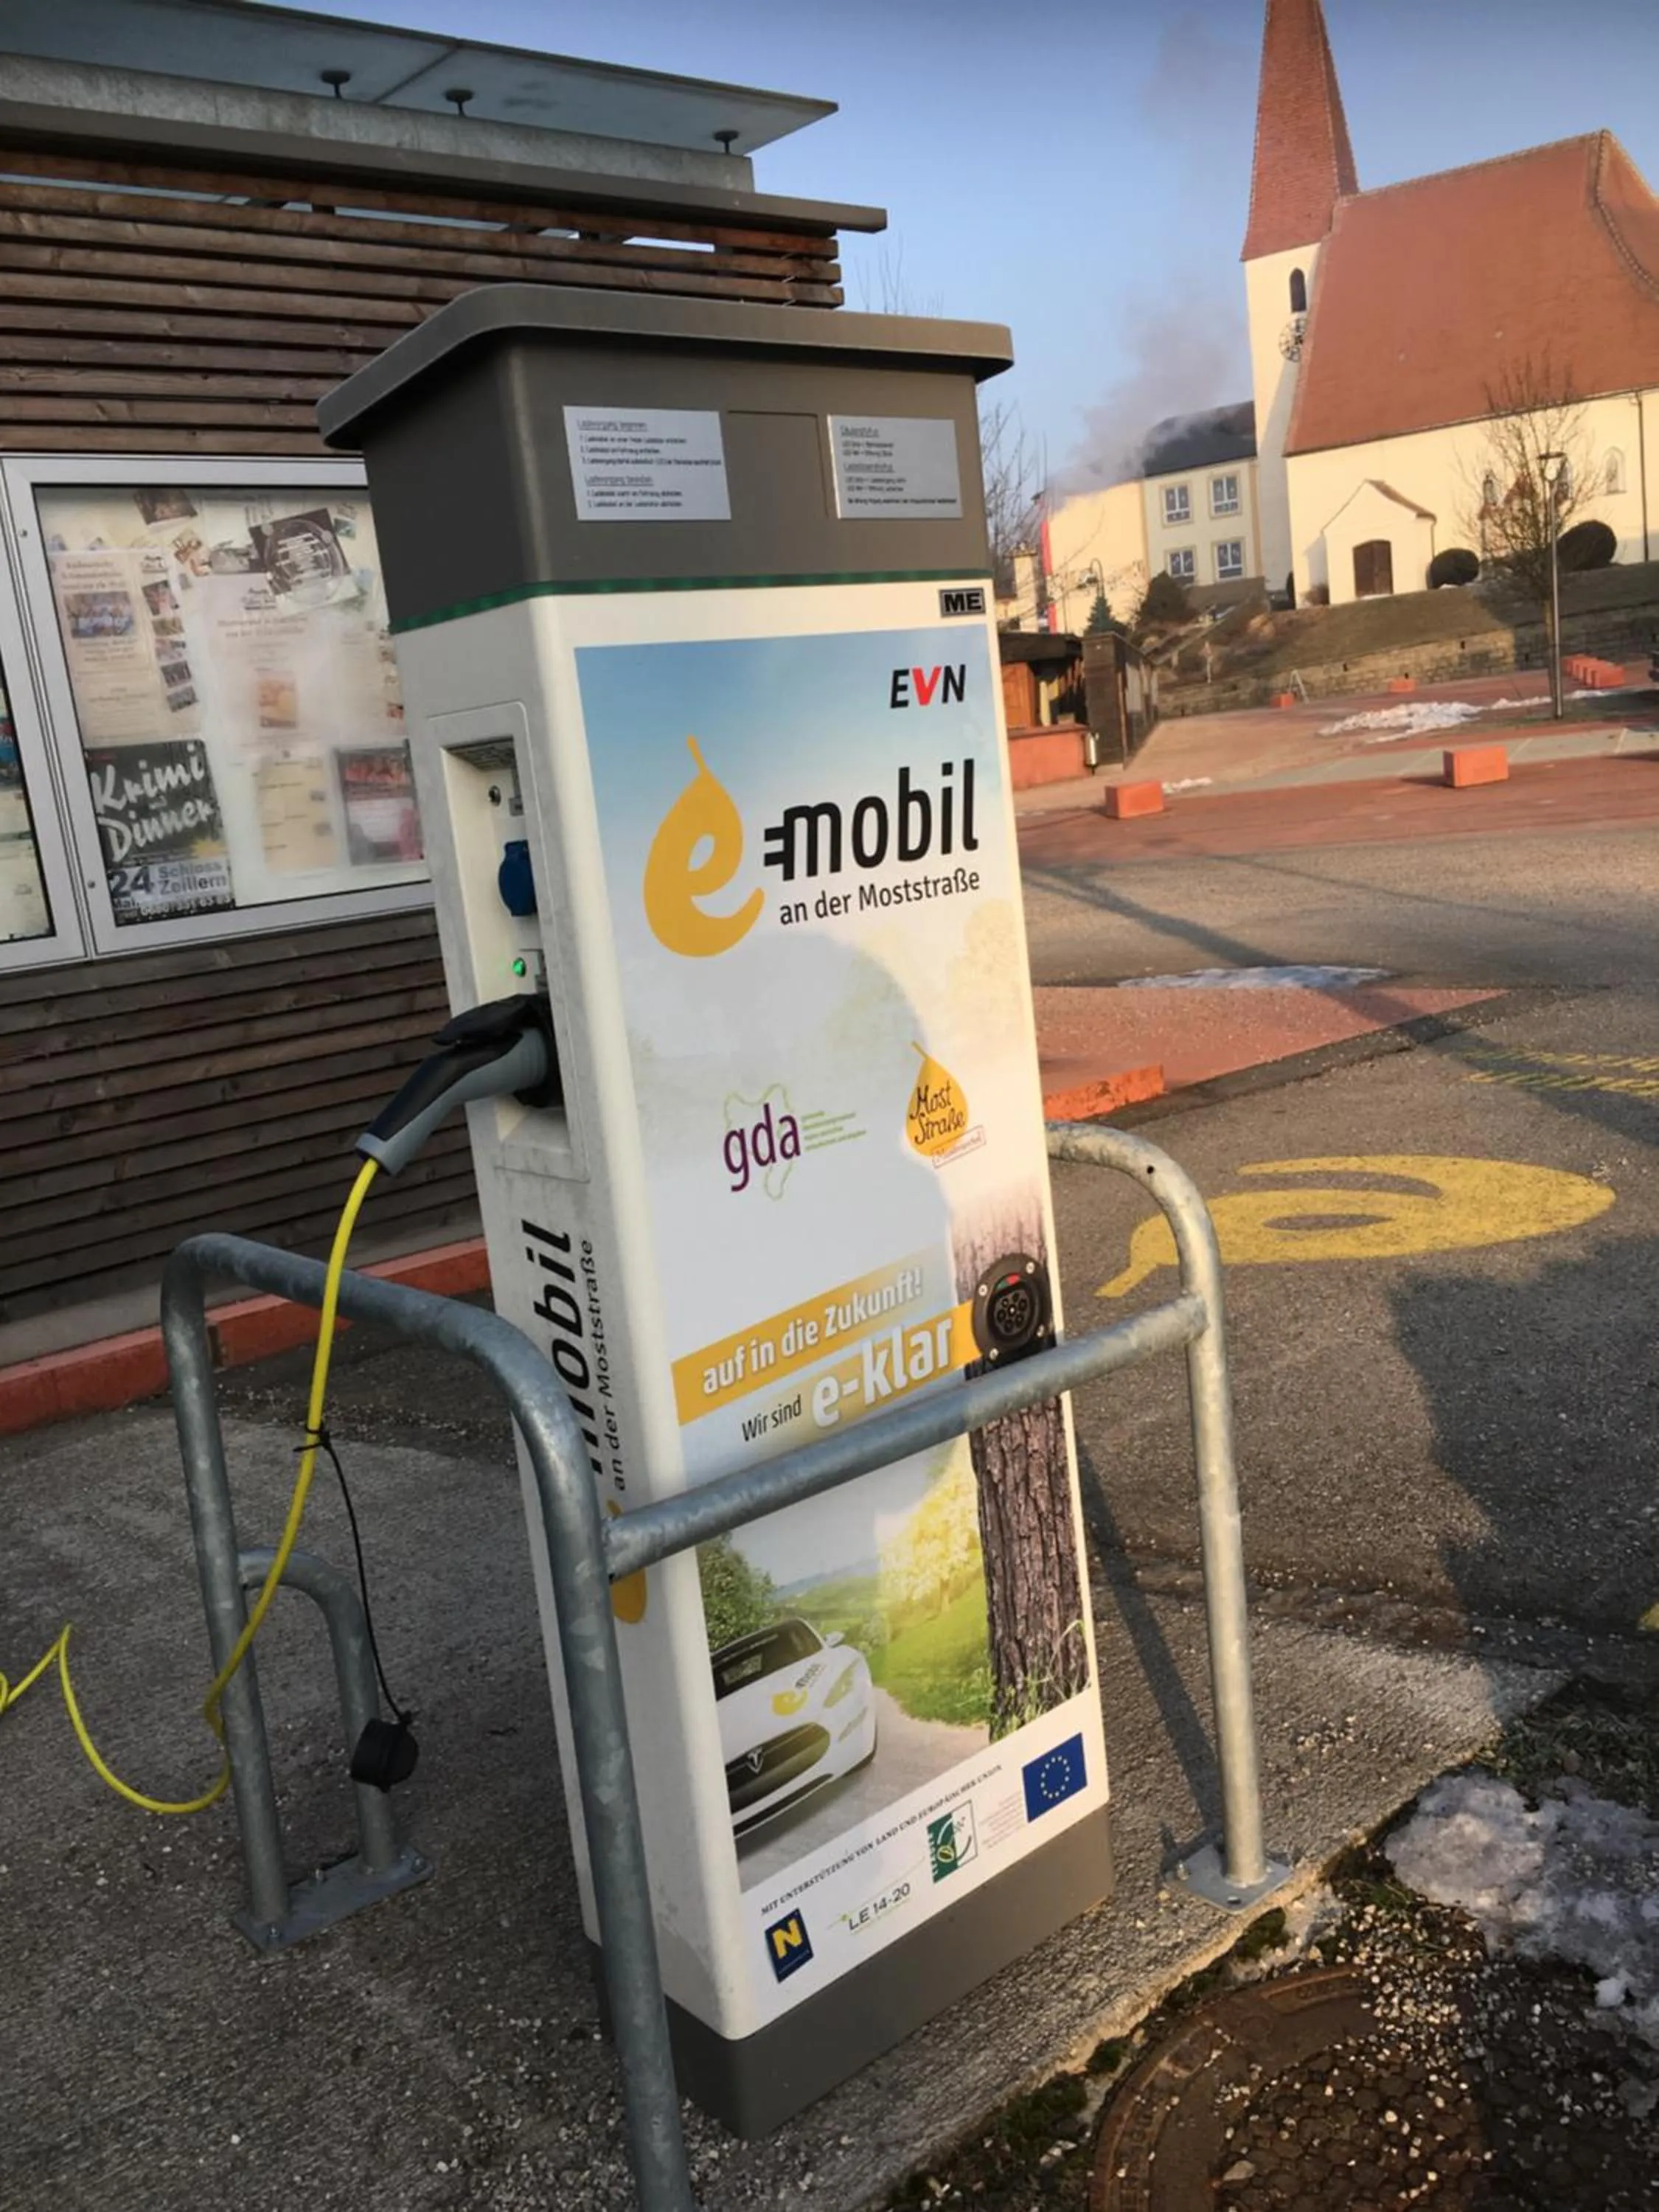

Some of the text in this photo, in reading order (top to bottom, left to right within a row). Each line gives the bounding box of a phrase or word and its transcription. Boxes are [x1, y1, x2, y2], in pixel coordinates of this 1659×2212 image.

[945, 591, 982, 613] ME
[890, 664, 966, 709] EVN
[90, 743, 206, 814] Krimi
[97, 799, 215, 863] Dinner
[779, 867, 980, 925] an der Moststraße
[909, 1079, 952, 1120] Most
[723, 1102, 801, 1192] gda
[703, 1266, 922, 1395] auf in die Zukunft!
[580, 1239, 626, 1492] an der Moststraße
[742, 1318, 953, 1442] Wir sind e-klar
[772, 1919, 803, 1959] N
[848, 1907, 870, 1930] LE
